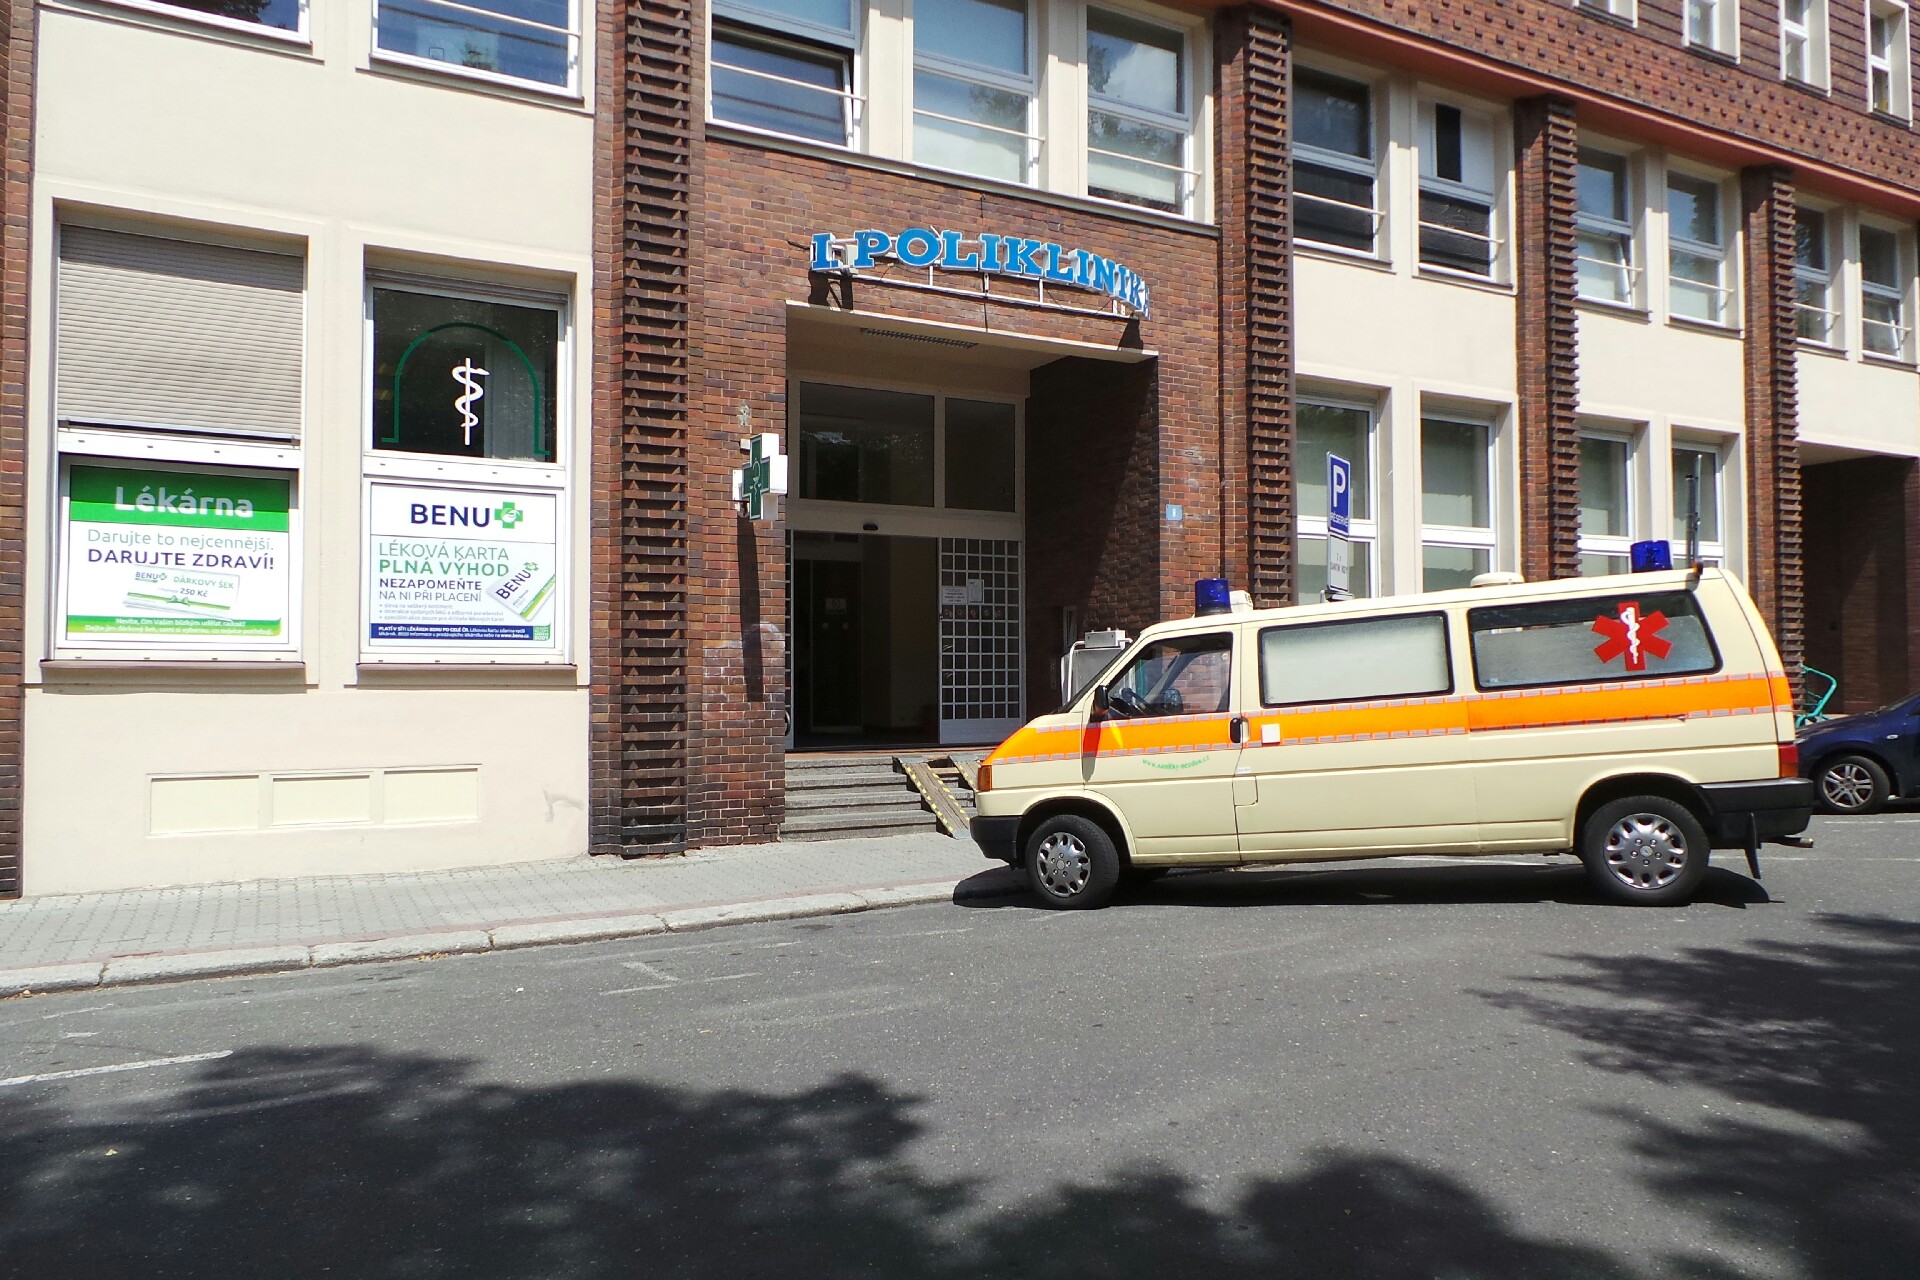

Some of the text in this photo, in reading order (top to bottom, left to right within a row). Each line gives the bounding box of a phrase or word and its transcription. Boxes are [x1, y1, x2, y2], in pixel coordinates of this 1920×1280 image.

[1332, 464, 1346, 508] P
[115, 484, 254, 518] Lékárna
[410, 503, 491, 528] BENU
[87, 528, 274, 553] Darujte to nejcennější.
[379, 539, 510, 561] LÉKOVÁ KARTA
[87, 548, 275, 570] DARUJTE ZDRAVÍ!
[379, 557, 510, 577] PLNÁ VÝHOD
[135, 571, 159, 580] BENU
[173, 575, 234, 589] DÁRKOVÝ ŠEK
[379, 577, 482, 591] NEZAPOMEŇTE
[495, 569, 532, 600] BENU
[179, 587, 195, 596] 250
[197, 590, 208, 598] Kč
[379, 590, 482, 602] NA NI PŘI PLACENÍ
